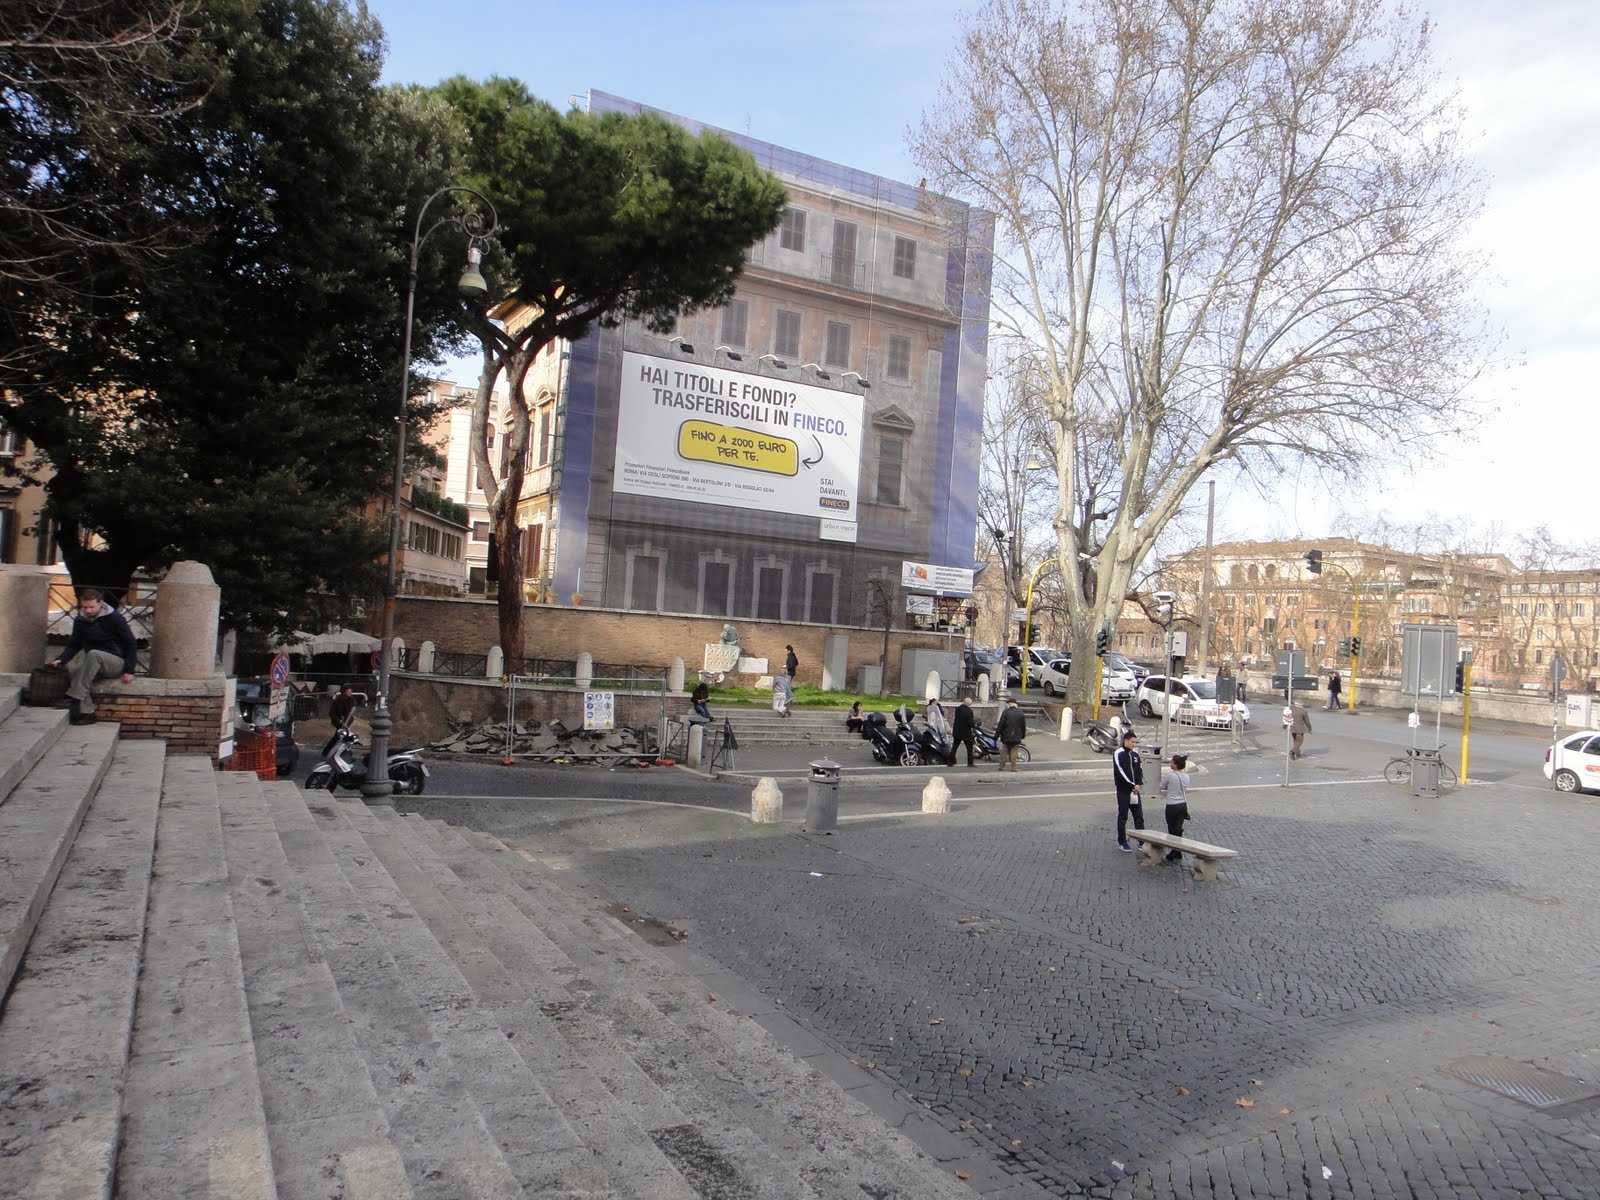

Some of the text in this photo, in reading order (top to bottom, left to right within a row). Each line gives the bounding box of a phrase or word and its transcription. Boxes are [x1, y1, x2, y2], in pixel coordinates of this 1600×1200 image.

[640, 365, 797, 408] HAI TITOLI E FONDI?
[652, 388, 848, 436] TRASFERISCILI IN FINECO.
[690, 430, 787, 454] FINO A 2000 EURO
[716, 446, 759, 462] PER TE.
[820, 478, 834, 486] STAI
[820, 486, 848, 497] DAVANTI.
[821, 498, 848, 508] FINECO
